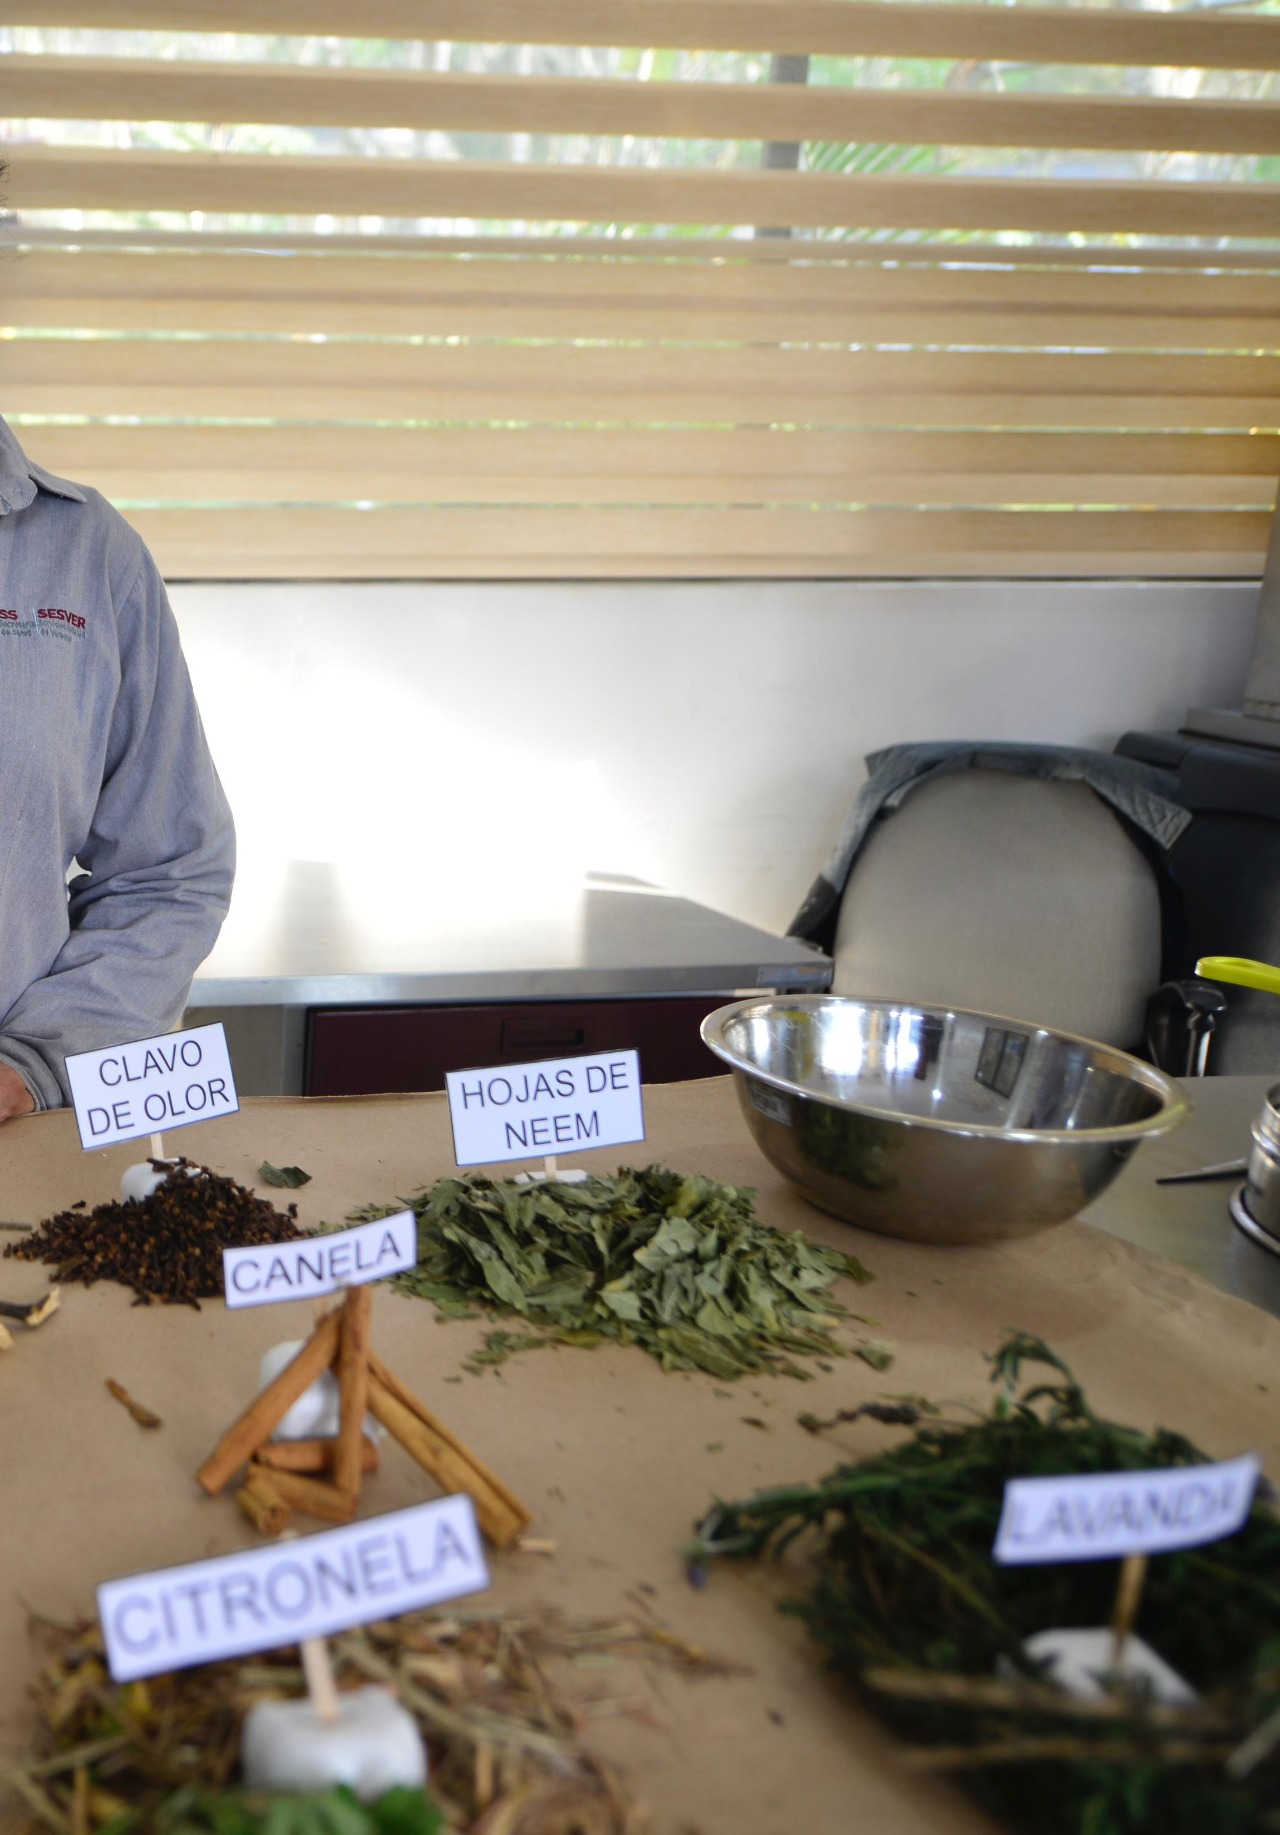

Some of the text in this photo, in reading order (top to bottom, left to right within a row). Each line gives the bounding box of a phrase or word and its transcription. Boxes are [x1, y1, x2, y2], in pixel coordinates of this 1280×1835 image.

[0, 609, 18, 621] SS
[37, 608, 86, 629] SESVER
[99, 1040, 202, 1087] CLAVO
[461, 1062, 629, 1110] HOJAS DE
[87, 1078, 230, 1136] DE OLOR
[504, 1110, 600, 1149] NEEM
[232, 1230, 401, 1293] CANELA
[112, 1517, 472, 1656] CITRONELA
